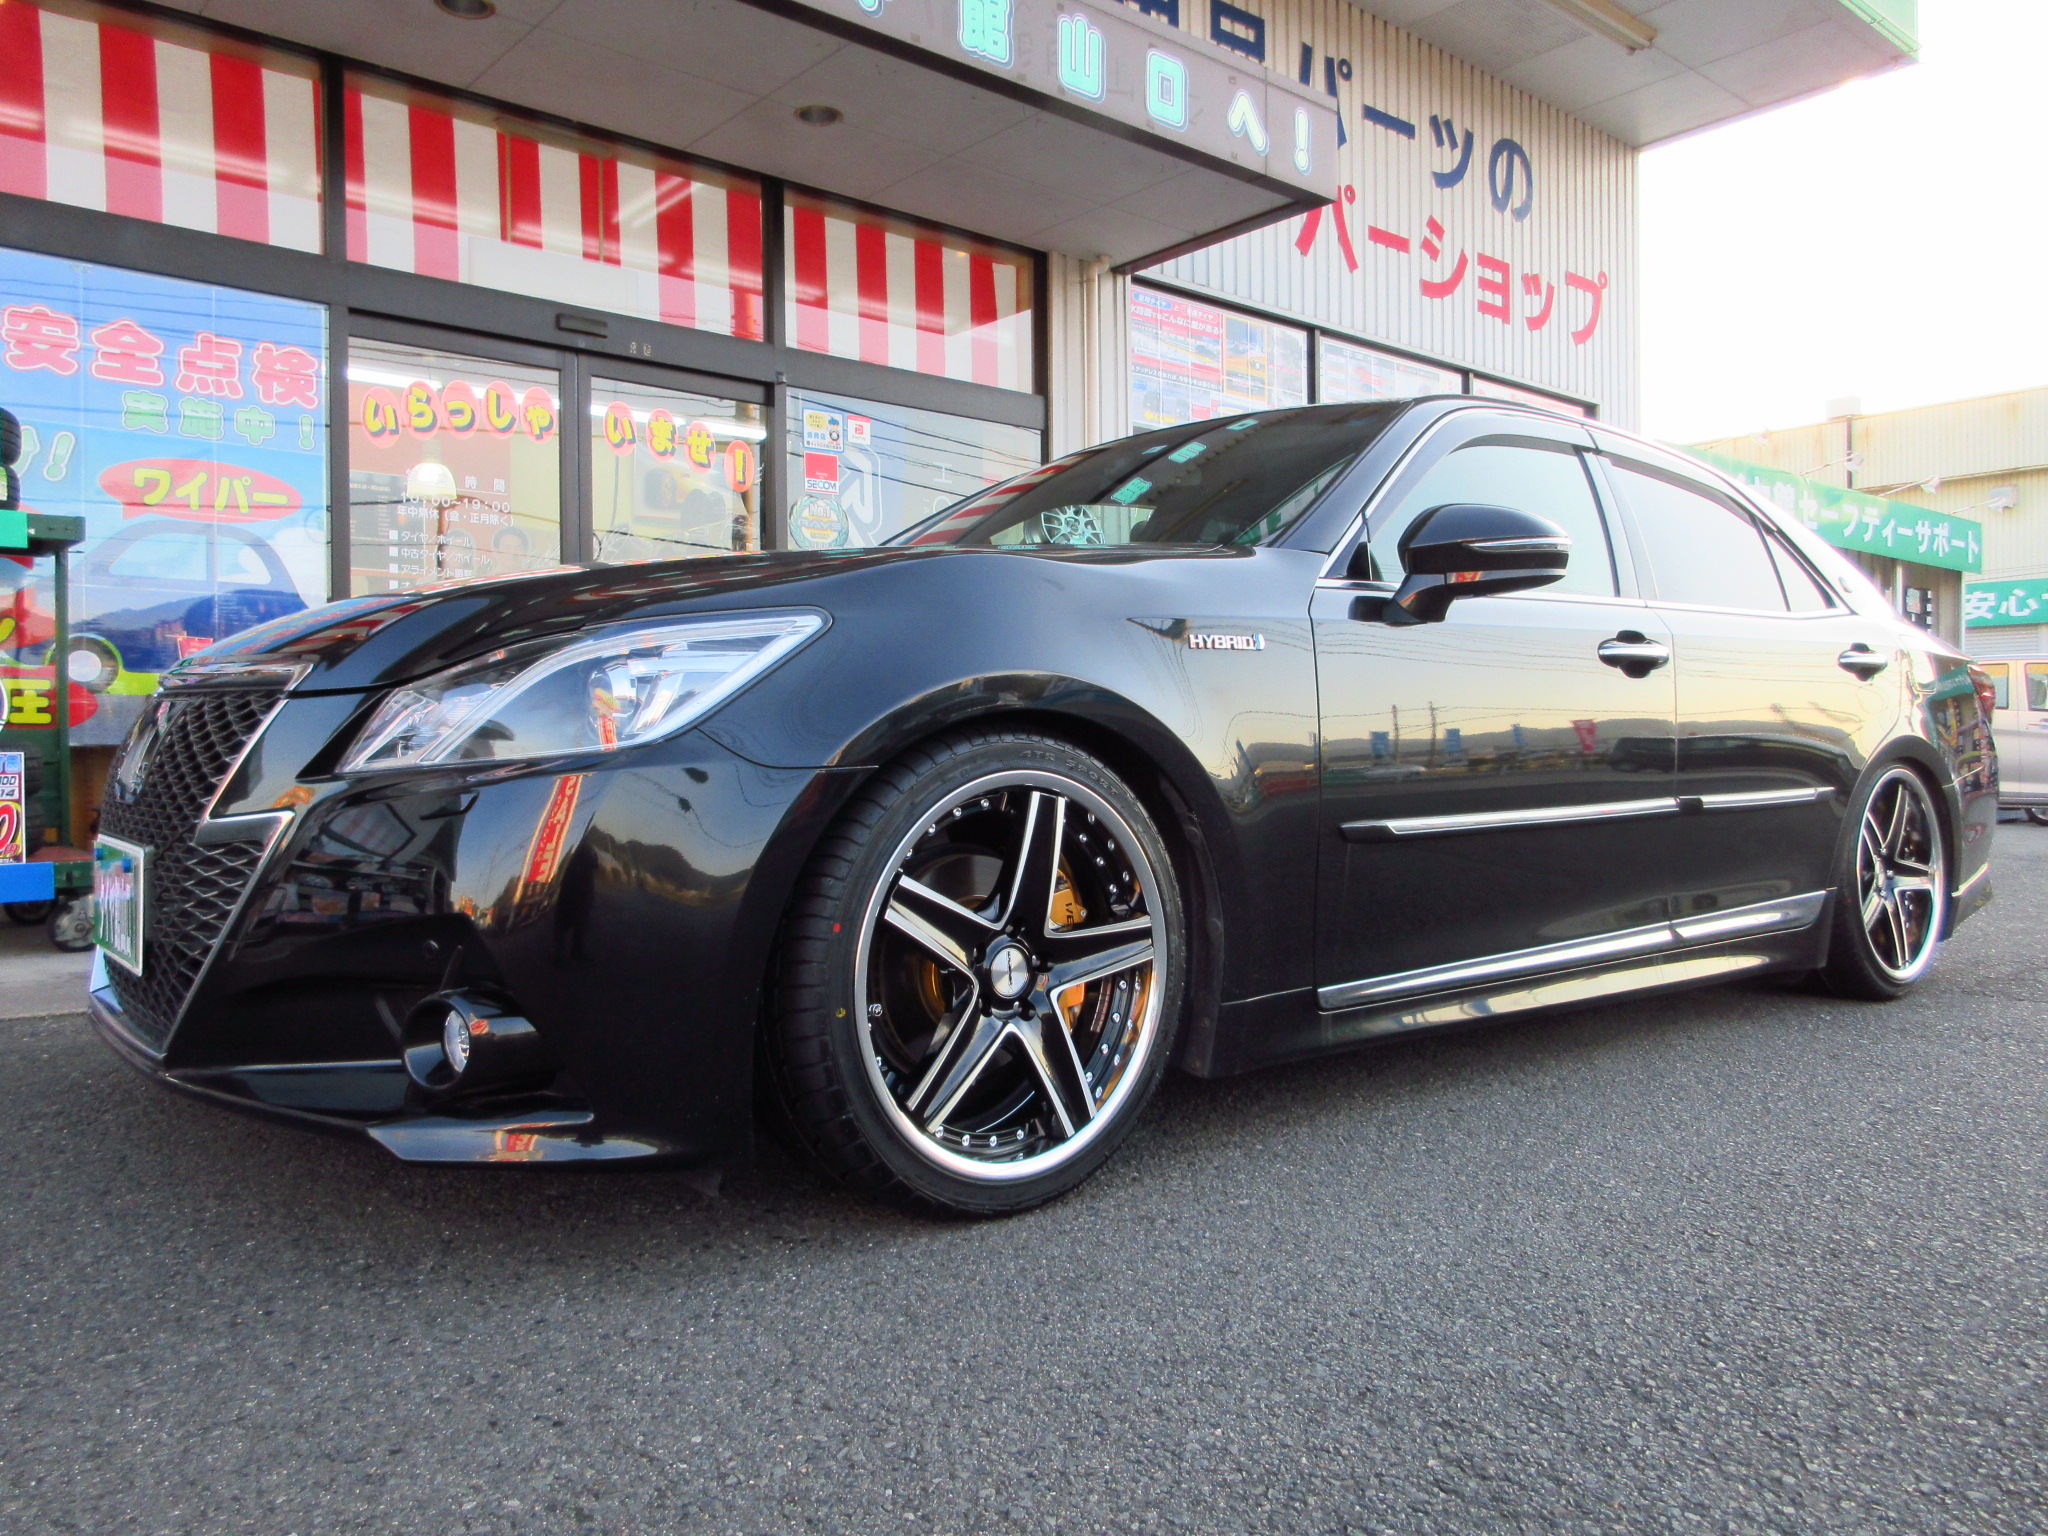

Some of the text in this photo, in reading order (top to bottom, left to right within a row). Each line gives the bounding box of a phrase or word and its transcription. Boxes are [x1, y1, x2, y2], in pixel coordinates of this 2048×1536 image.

[1294, 184, 1608, 346] パーショップ
[2, 304, 320, 410] 安全点検
[121, 390, 316, 452] 実施中!
[362, 386, 556, 444] いらっしゃ
[132, 465, 291, 511] ワイパー
[806, 479, 837, 491] SECOM
[1737, 473, 1981, 567] セーフティーサポート
[1964, 588, 2048, 620] 安心
[1188, 633, 1256, 651] HYBRID
[1065, 759, 1119, 796] SPORT
